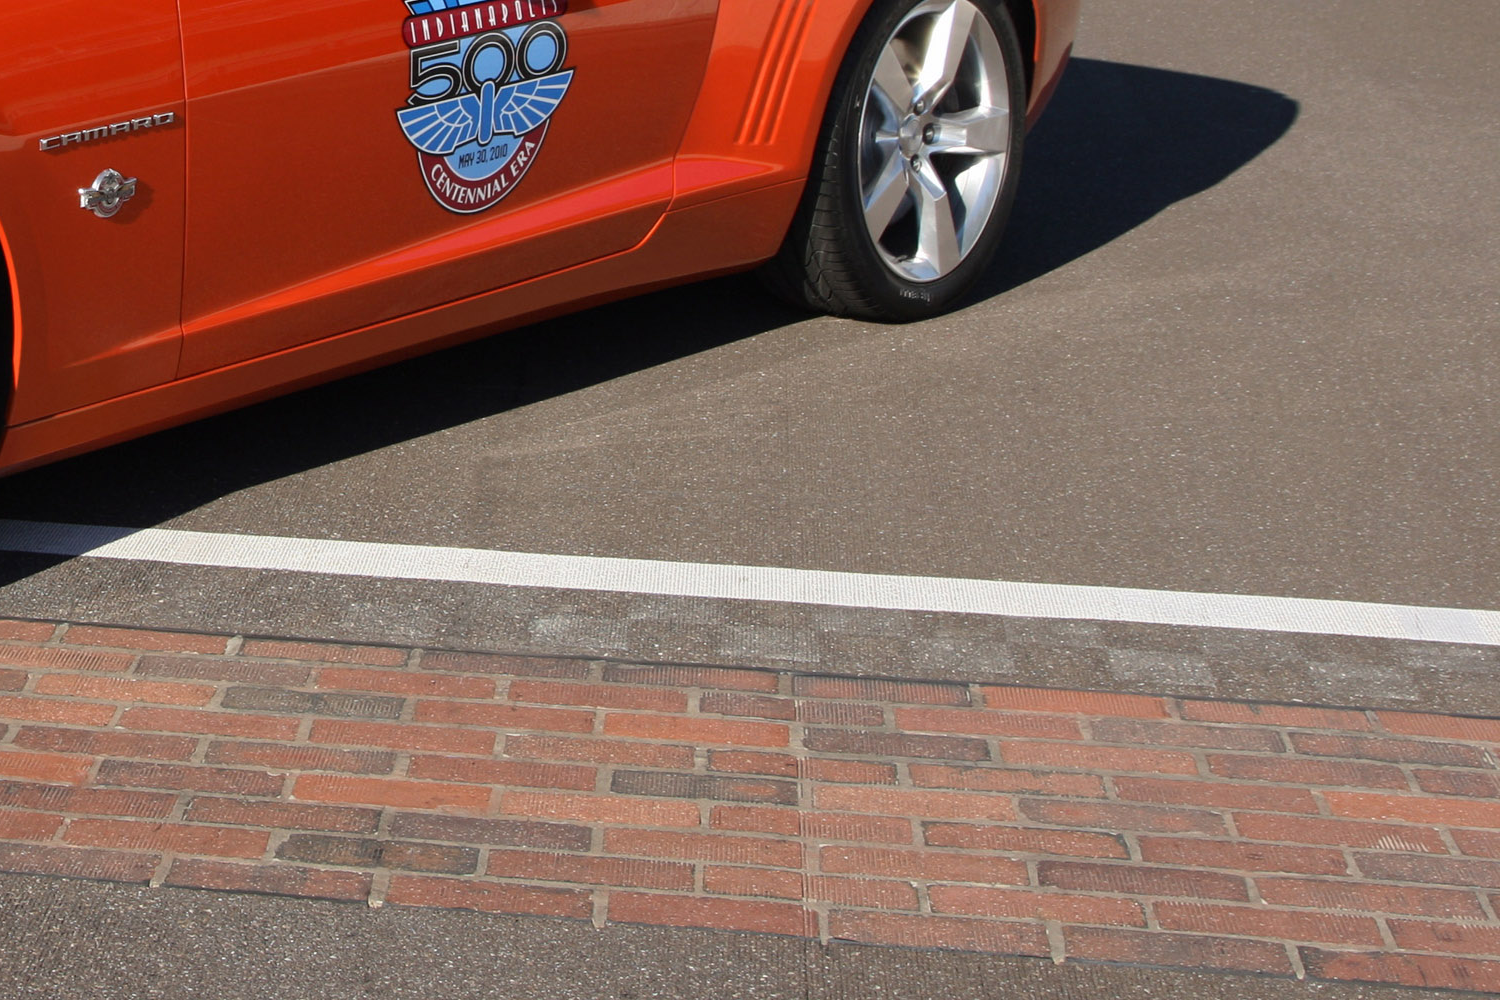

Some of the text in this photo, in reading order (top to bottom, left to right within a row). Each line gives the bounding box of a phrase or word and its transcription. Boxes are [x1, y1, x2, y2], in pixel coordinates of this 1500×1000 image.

[406, 20, 568, 107] 500
[39, 111, 175, 151] CAMARO
[458, 143, 508, 169] MAY 30, 2010
[430, 140, 536, 204] CENTENNIAL ERA
